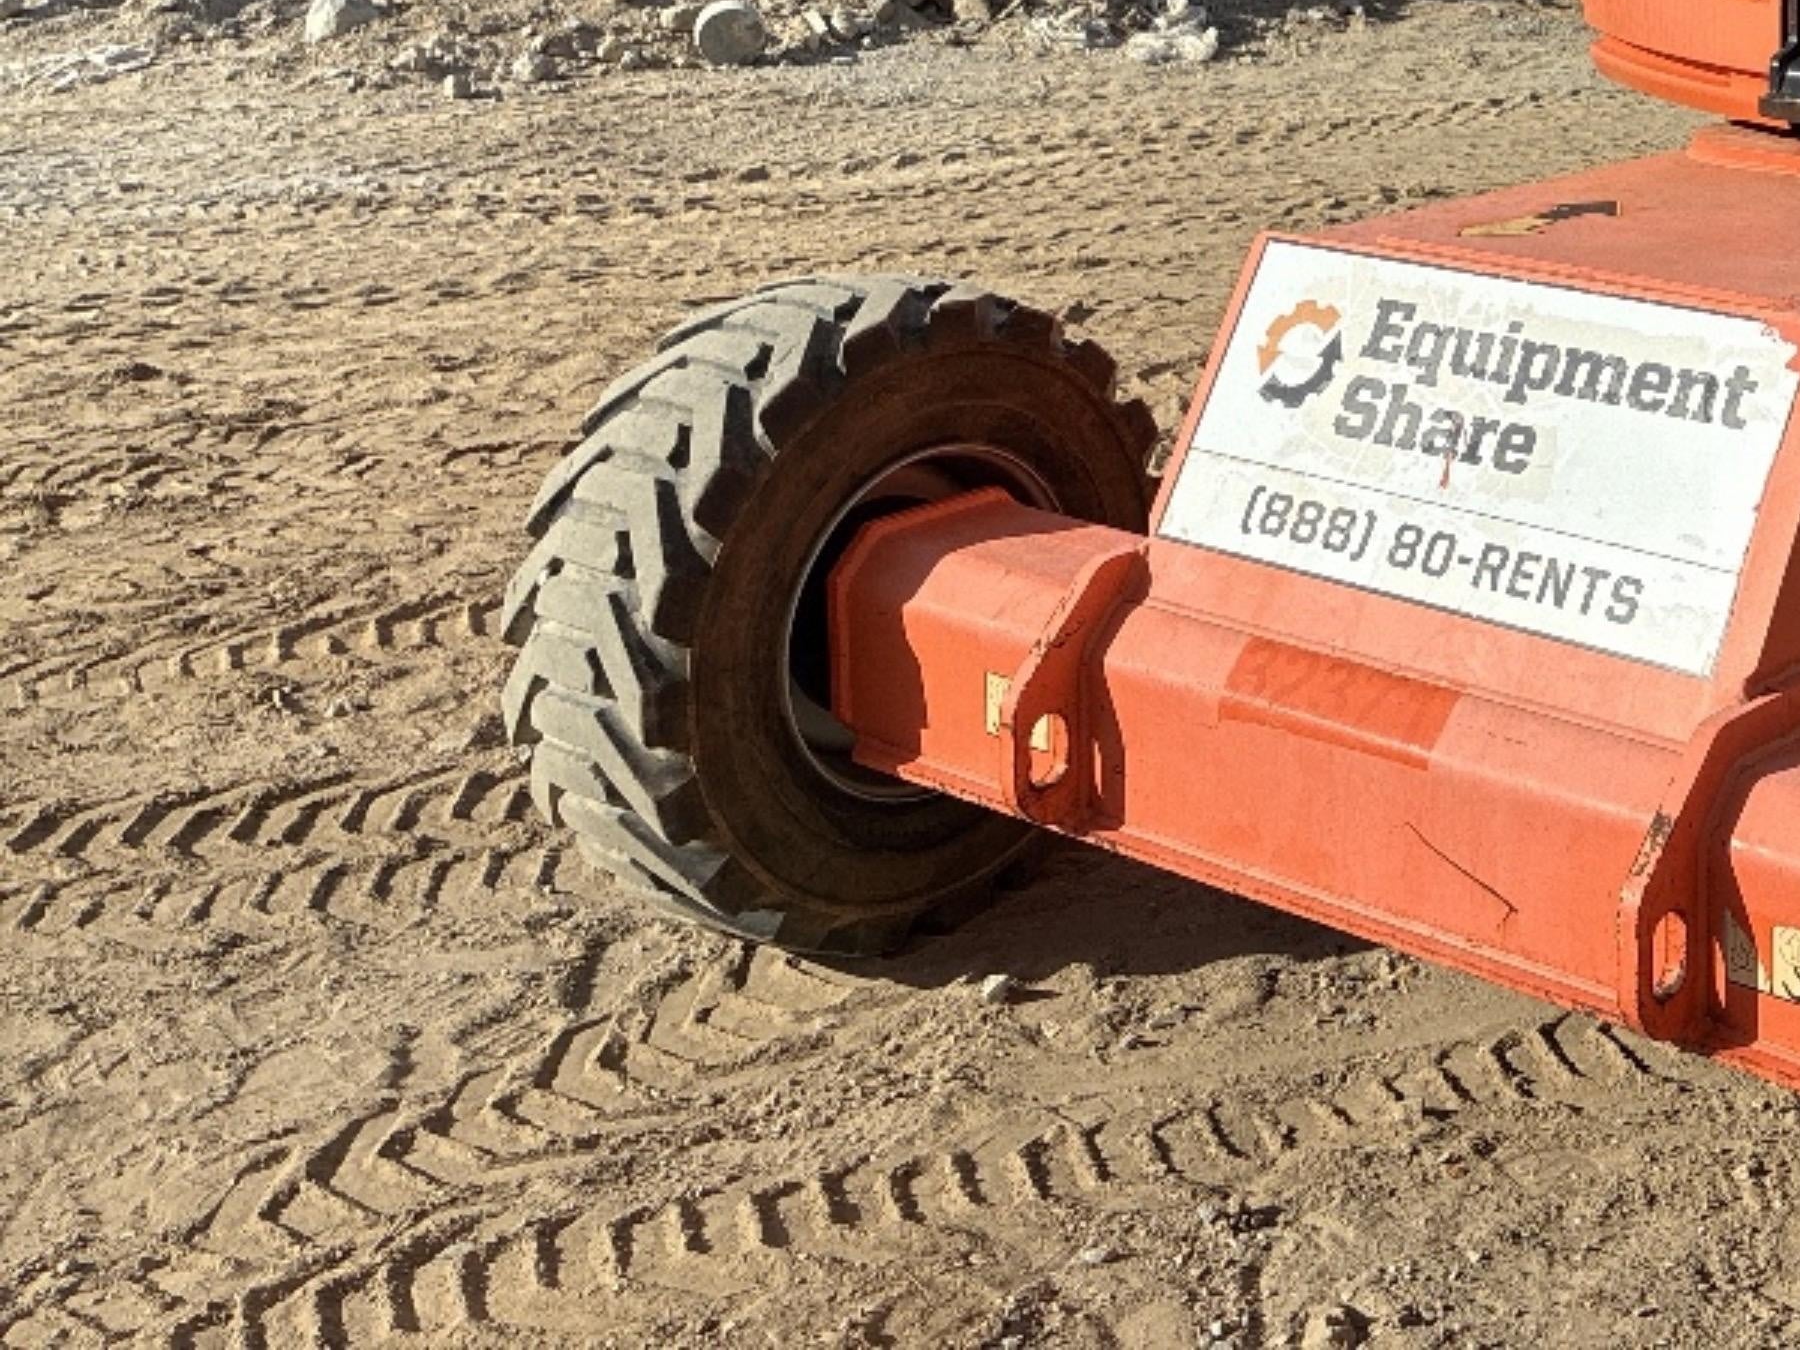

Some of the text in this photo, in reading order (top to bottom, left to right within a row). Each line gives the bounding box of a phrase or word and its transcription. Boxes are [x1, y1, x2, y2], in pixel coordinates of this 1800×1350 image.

[1333, 374, 1537, 475] Share
[1359, 297, 1758, 430] Equipment
[1241, 485, 1645, 625] (888) 80-RENTS
